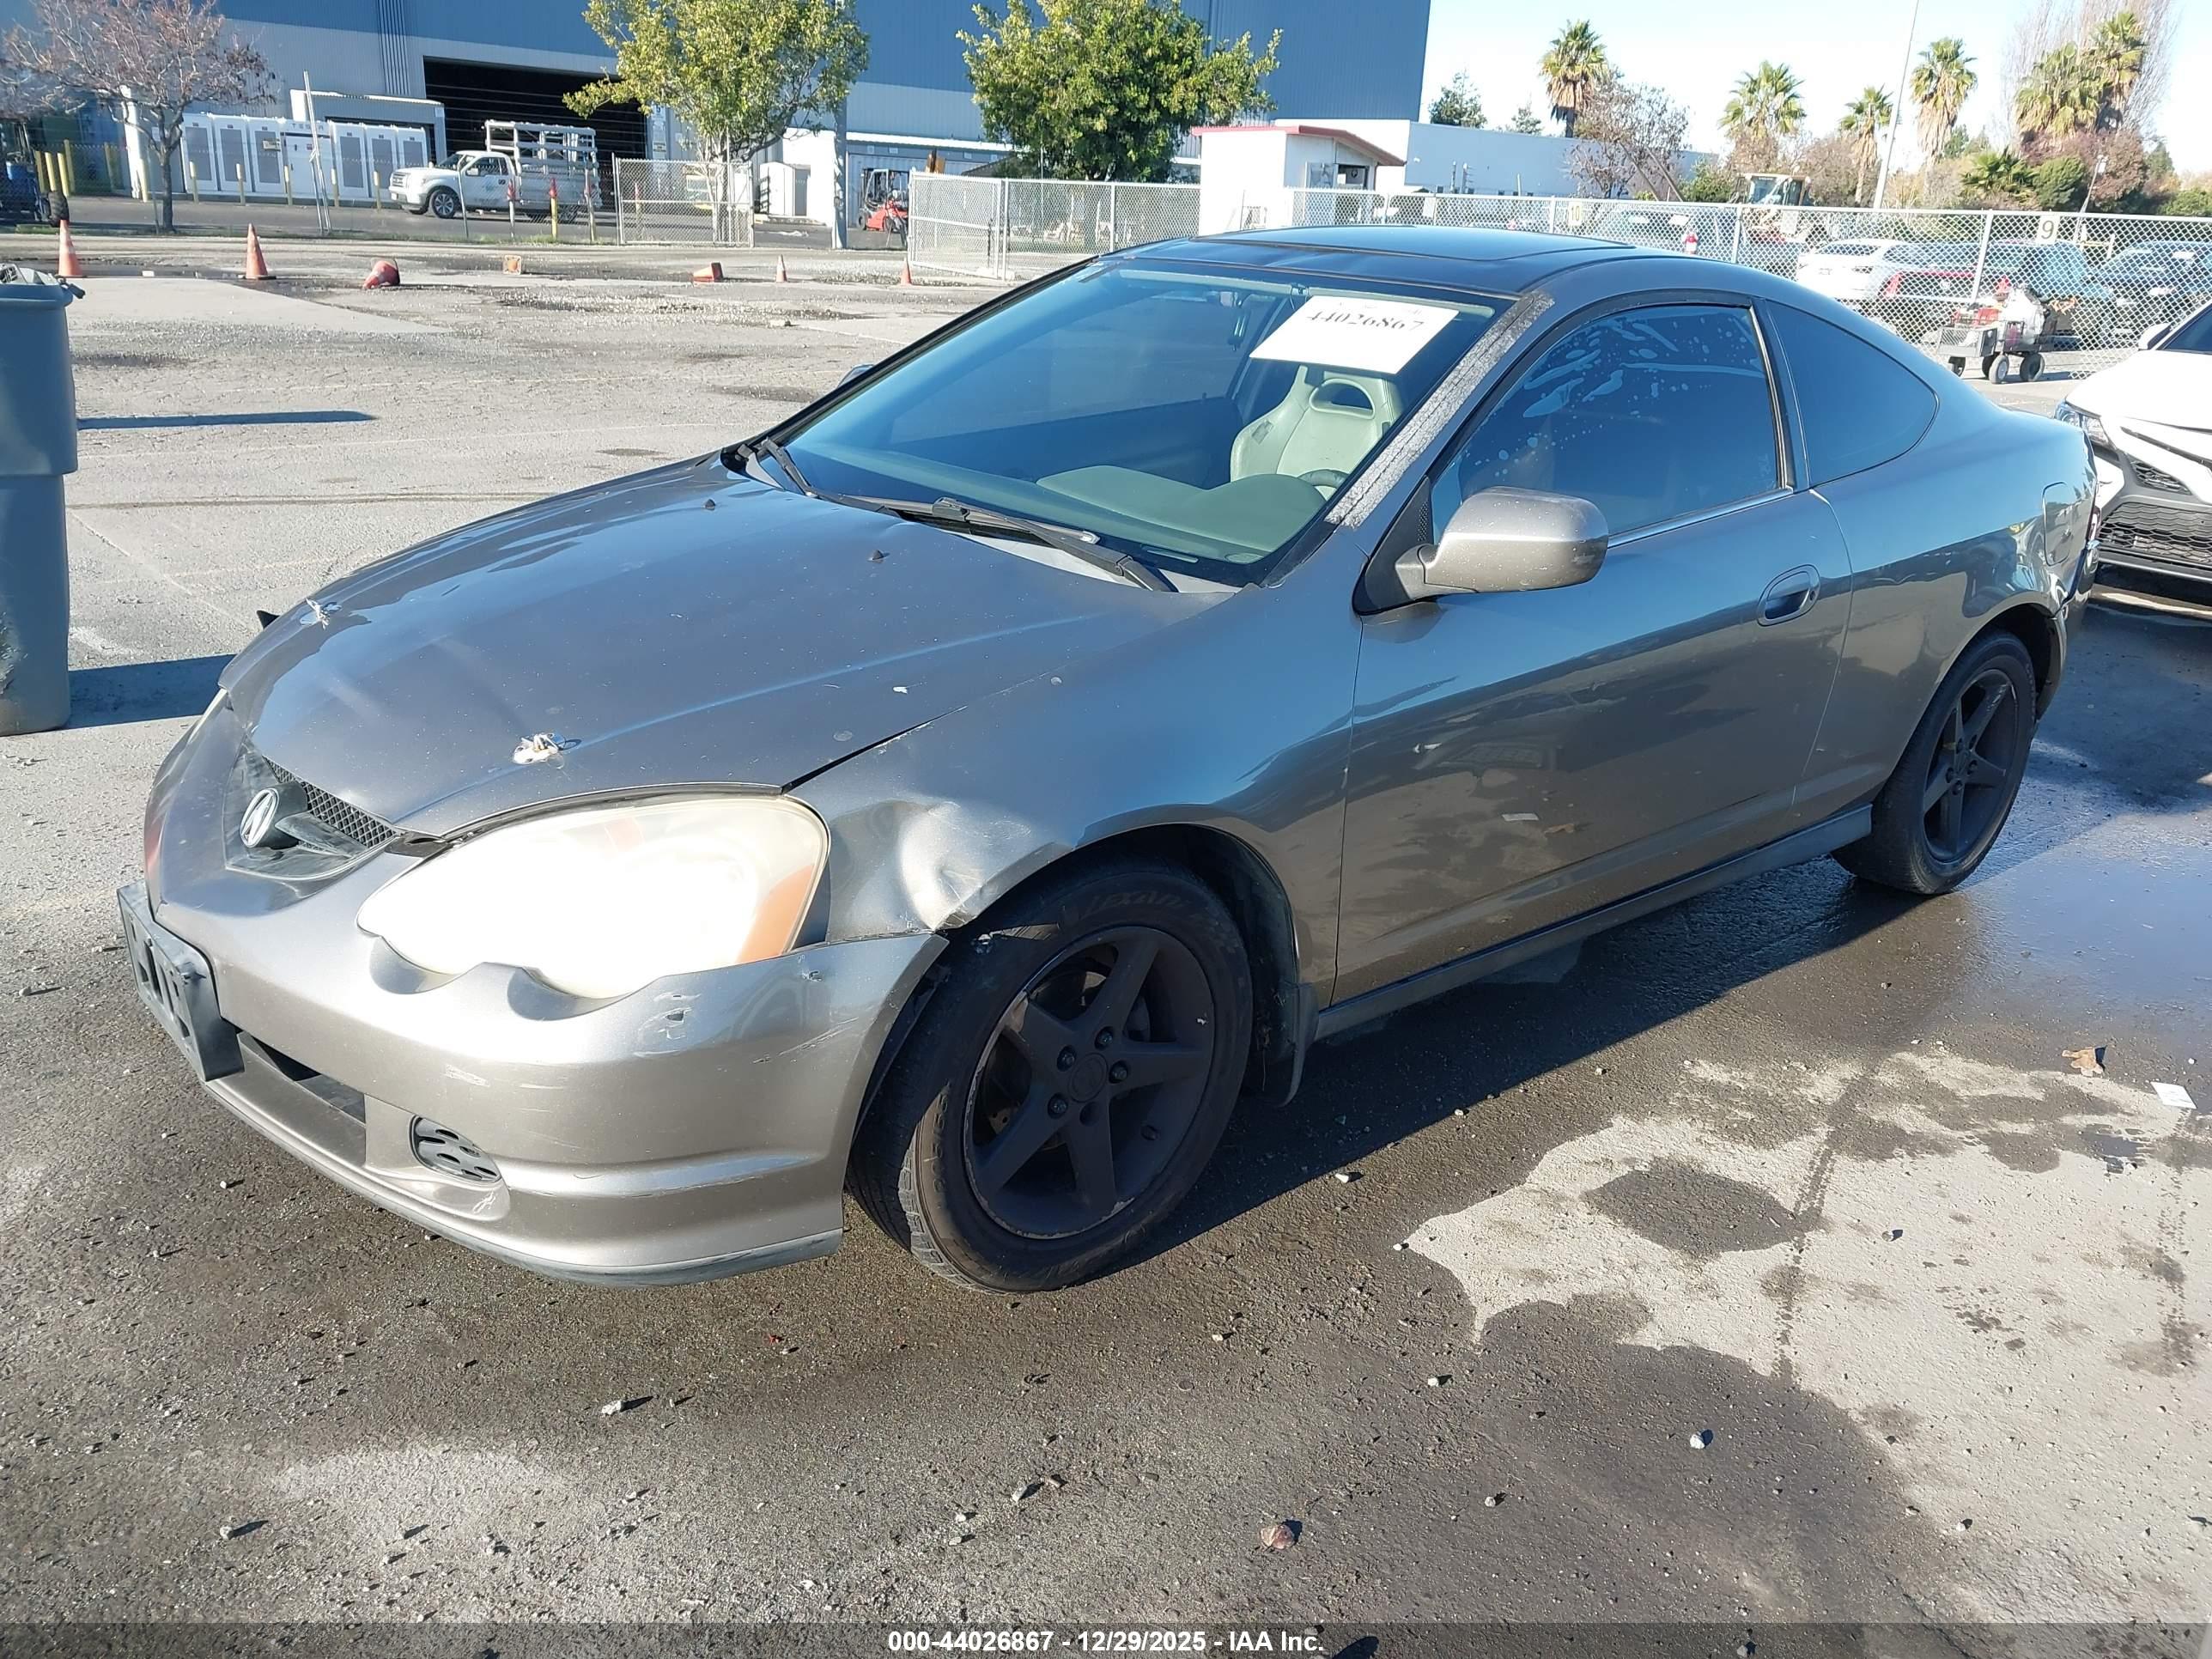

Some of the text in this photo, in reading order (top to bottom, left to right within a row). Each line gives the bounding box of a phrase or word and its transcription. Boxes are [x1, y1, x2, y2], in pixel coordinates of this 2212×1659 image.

[1571, 205, 1580, 221] 10
[2041, 220, 2054, 240] 9
[1307, 310, 1425, 331] 44026867
